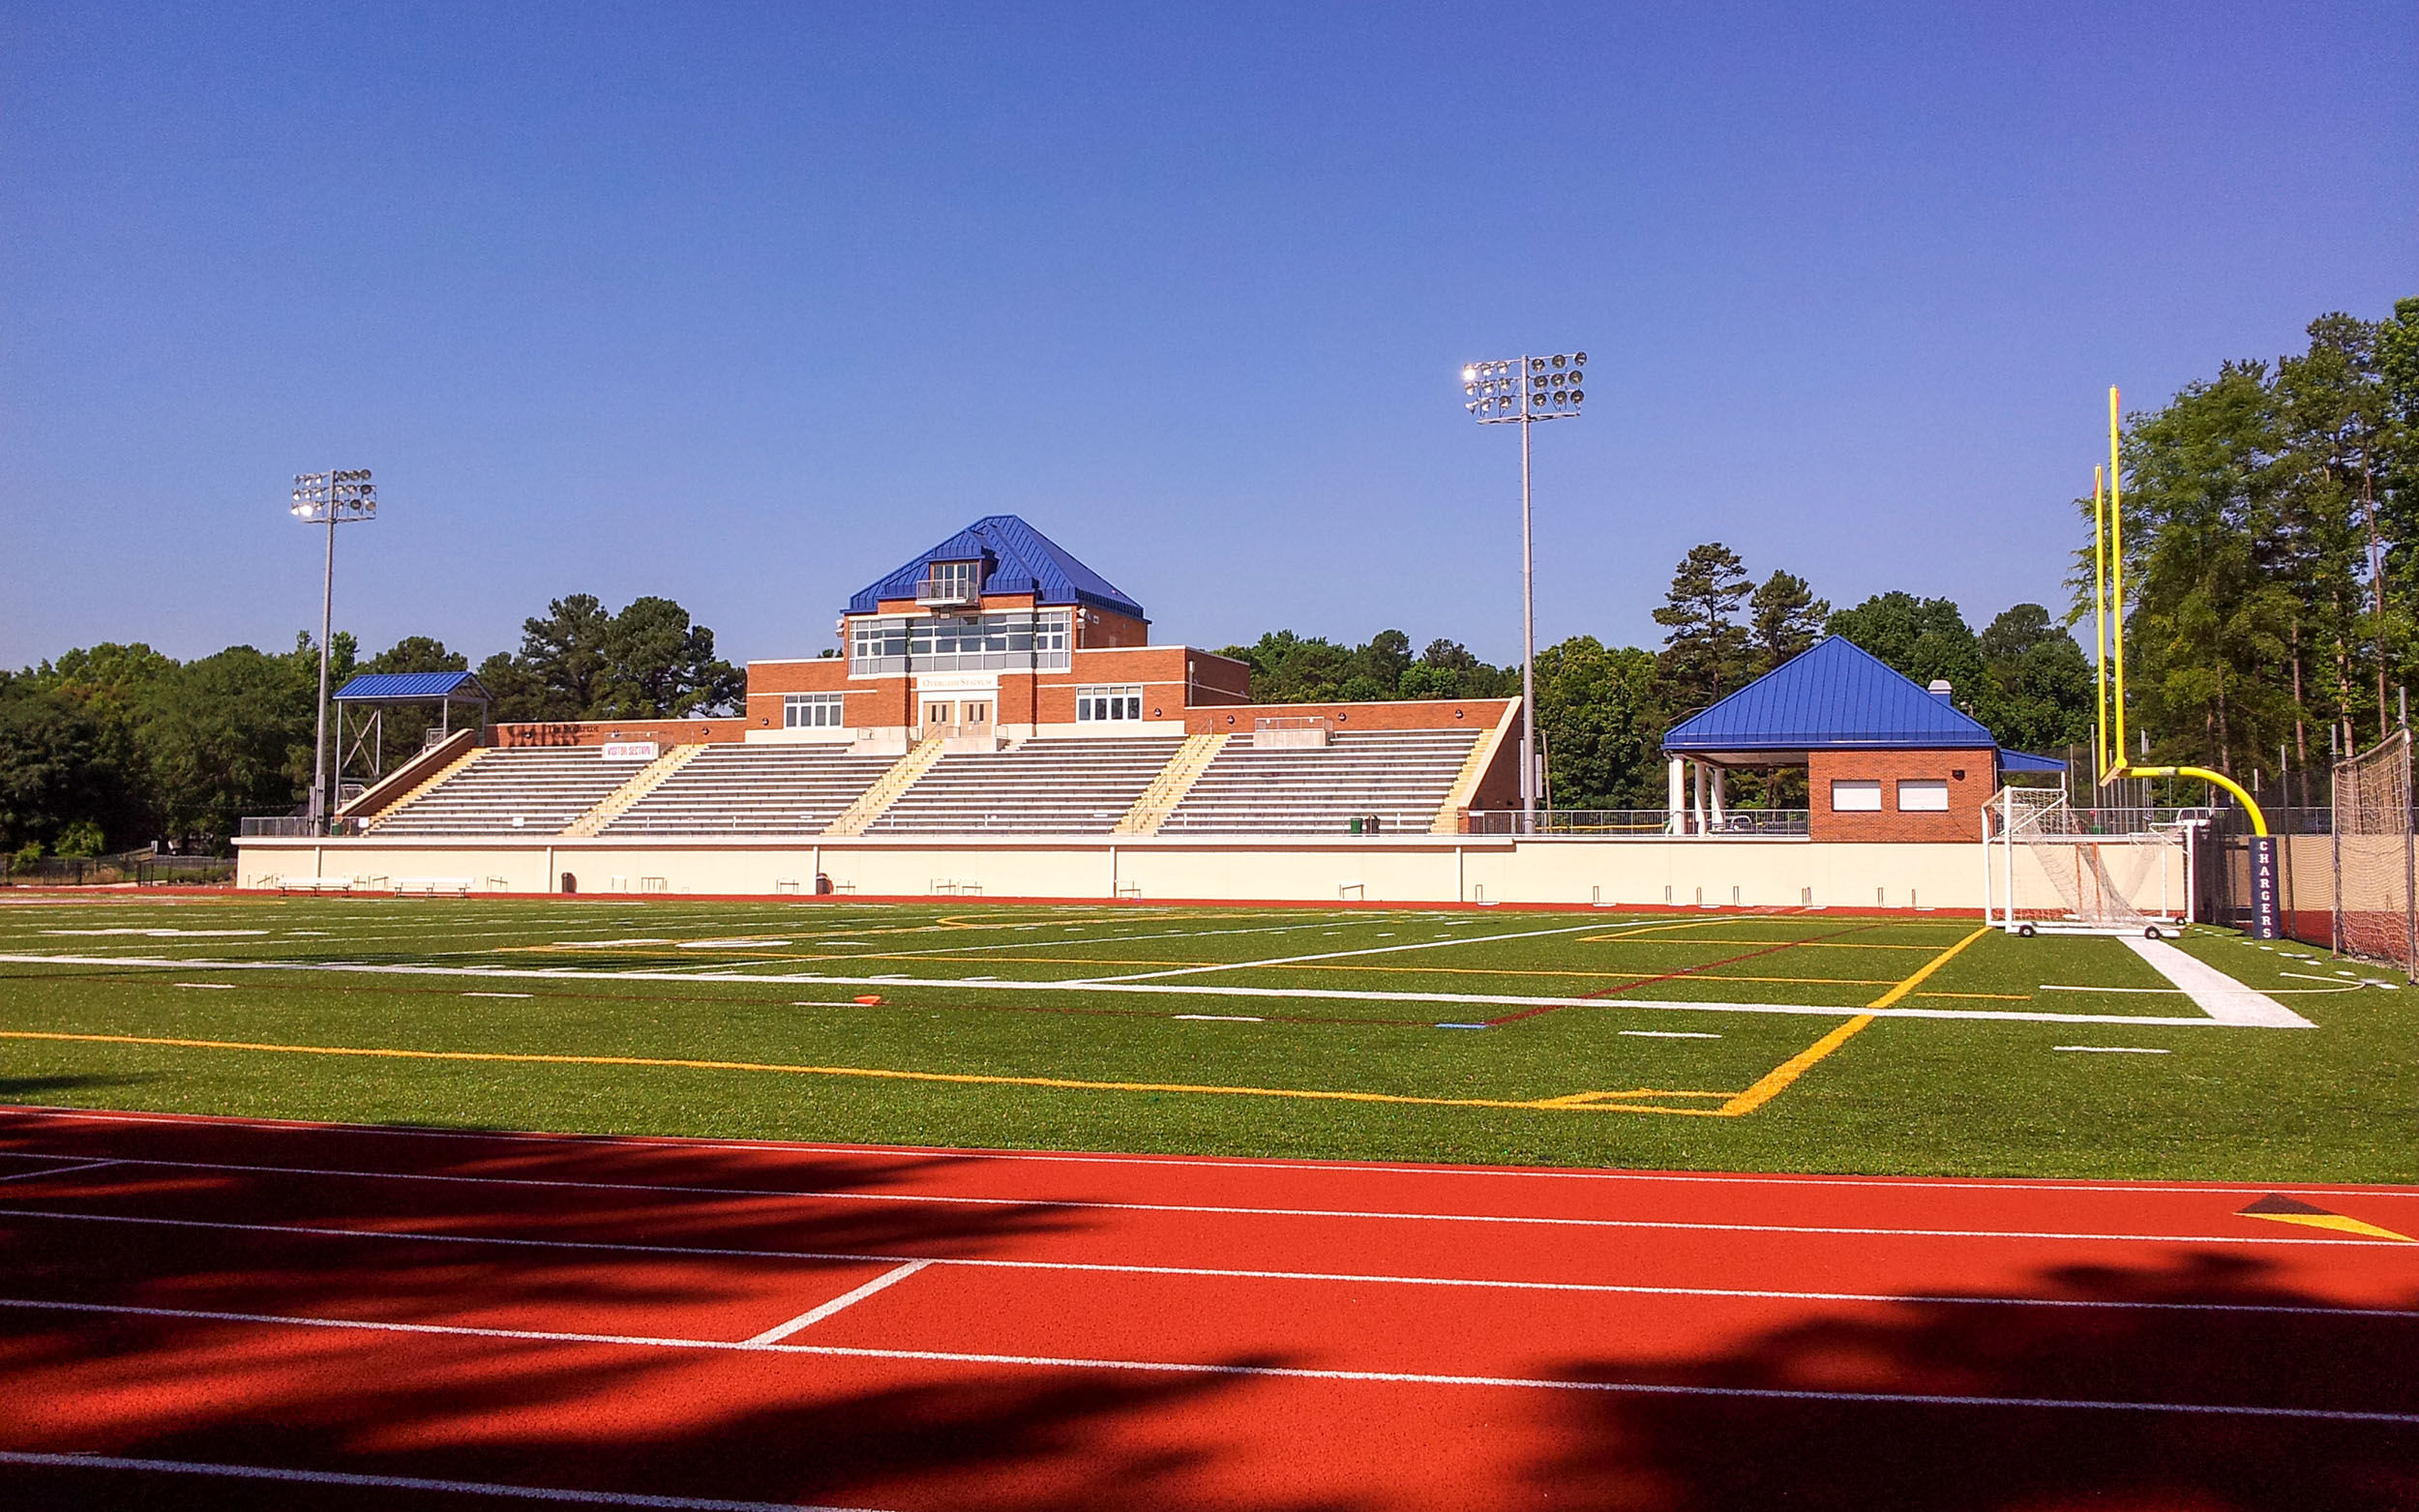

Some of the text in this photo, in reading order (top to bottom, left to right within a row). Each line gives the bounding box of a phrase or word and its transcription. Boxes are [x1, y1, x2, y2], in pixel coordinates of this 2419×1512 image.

[608, 745, 650, 756] VISITOR SECTION
[2258, 841, 2272, 938] CHARGERS
